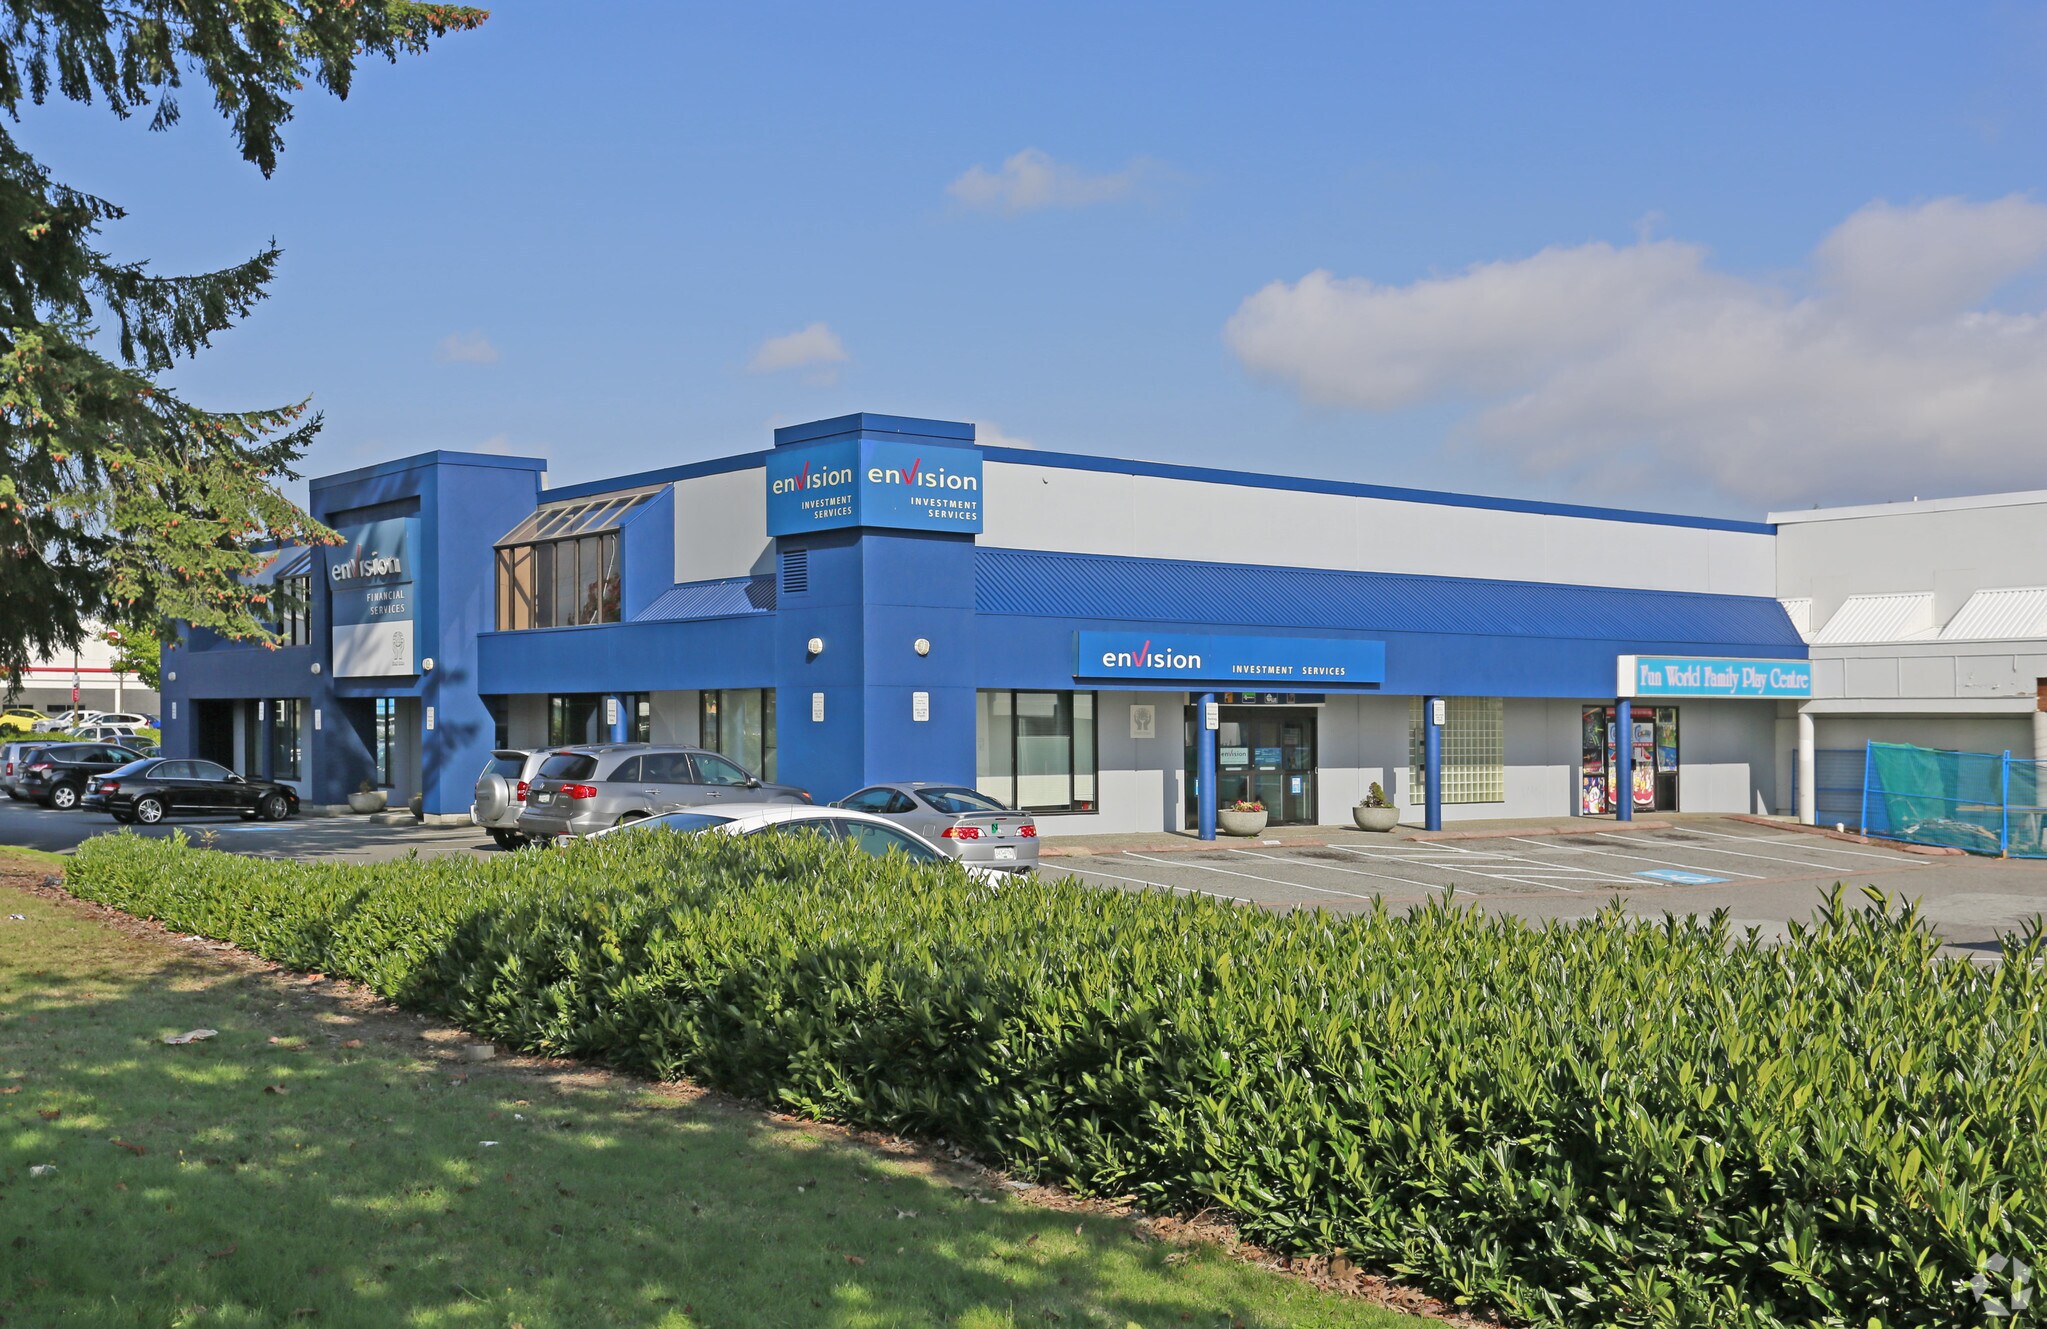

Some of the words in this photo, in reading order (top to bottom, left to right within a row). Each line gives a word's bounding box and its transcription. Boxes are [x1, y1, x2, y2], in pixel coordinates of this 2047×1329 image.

[772, 461, 852, 494] envision
[868, 458, 977, 490] envision
[801, 495, 852, 509] INVESTMENT
[911, 497, 977, 510] INVESTMENT
[814, 507, 852, 519] SERVICES
[928, 509, 977, 520] SERVICES
[367, 590, 405, 602] FINANCIAL
[370, 604, 405, 615] SERVICES
[1102, 640, 1201, 669] envision
[1232, 665, 1293, 675] INVESTMENT
[1302, 666, 1346, 676] SERVICES
[1640, 665, 1662, 687] Fun
[1665, 665, 1700, 688] World
[1704, 666, 1739, 694] Family
[1742, 667, 1767, 694] Play
[1770, 669, 1808, 689] Centre
